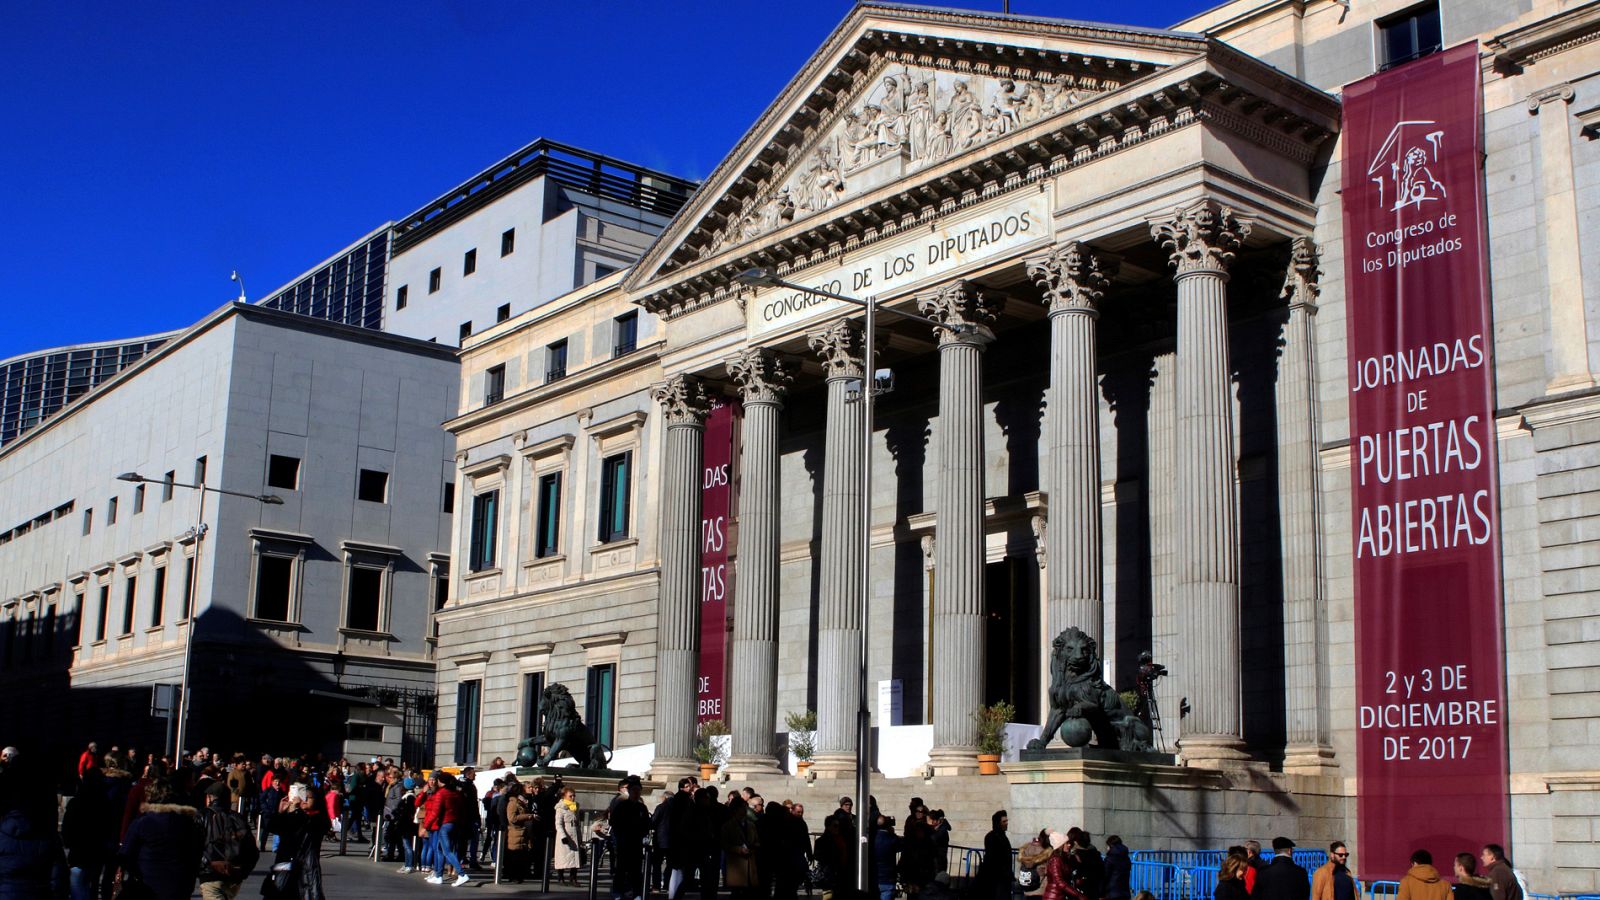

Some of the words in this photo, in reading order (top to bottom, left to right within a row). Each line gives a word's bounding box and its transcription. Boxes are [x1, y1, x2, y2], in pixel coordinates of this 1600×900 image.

[1366, 219, 1434, 248] Congreso
[1439, 212, 1457, 228] de
[763, 279, 842, 321] CONGRESO
[853, 267, 873, 291] DE
[884, 253, 915, 280] LOS
[928, 210, 1031, 265] DIPUTADOS
[1363, 258, 1383, 273] los
[1387, 236, 1462, 268] Diputados
[1352, 334, 1484, 392] JORNADAS
[1407, 389, 1428, 413] DE
[1359, 415, 1482, 486] PUERTAS
[1357, 489, 1491, 559] ABIERTAS
[1385, 671, 1397, 693] 2
[1403, 675, 1415, 698] y
[1421, 668, 1433, 691] 3
[1441, 664, 1468, 690] DE
[1360, 700, 1497, 729] DICIEMBRE
[1383, 736, 1411, 761] DE
[1418, 736, 1472, 760] 2017
